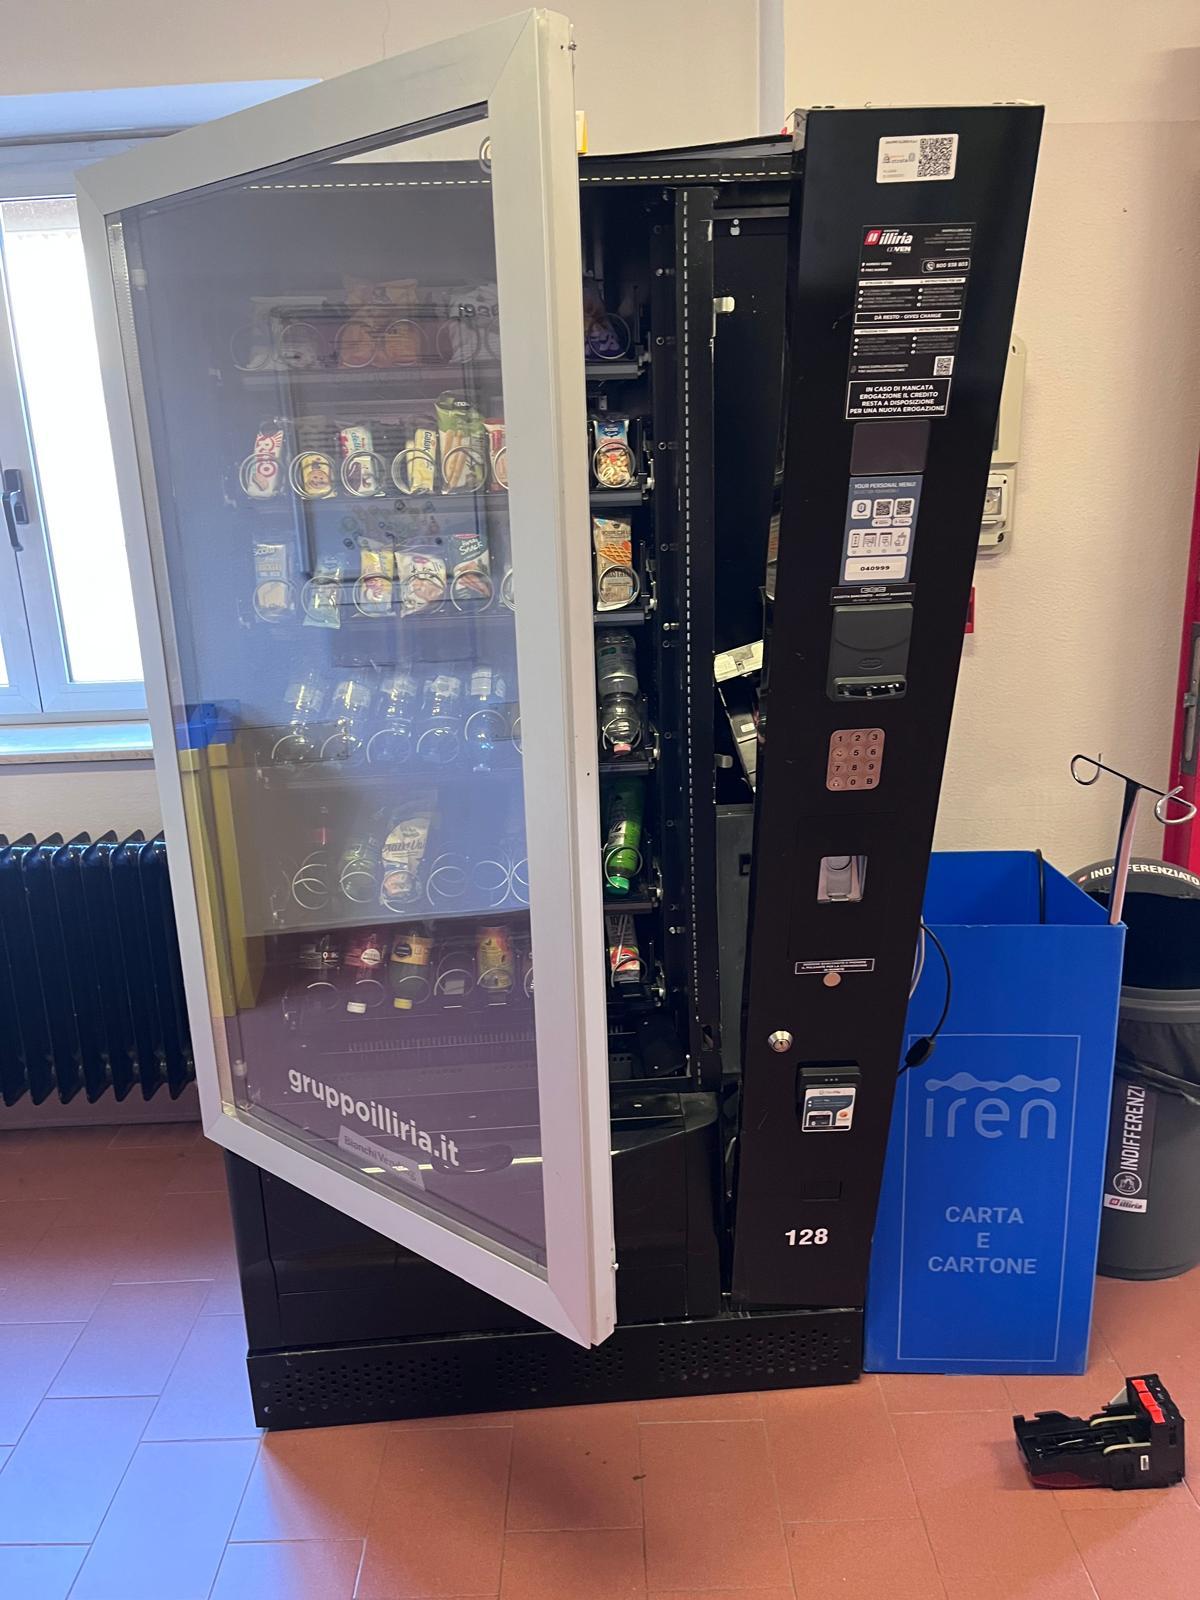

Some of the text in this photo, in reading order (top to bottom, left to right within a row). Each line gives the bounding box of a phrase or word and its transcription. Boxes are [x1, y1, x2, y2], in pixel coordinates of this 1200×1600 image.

[878, 232, 913, 245] illiria
[288, 1069, 460, 1166] gruppoilliria.it
[925, 1097, 1057, 1139] iren
[945, 1206, 1024, 1224] CARTA
[785, 1228, 829, 1246] 128
[976, 1232, 990, 1248] E
[927, 1256, 1037, 1274] CARTONE
